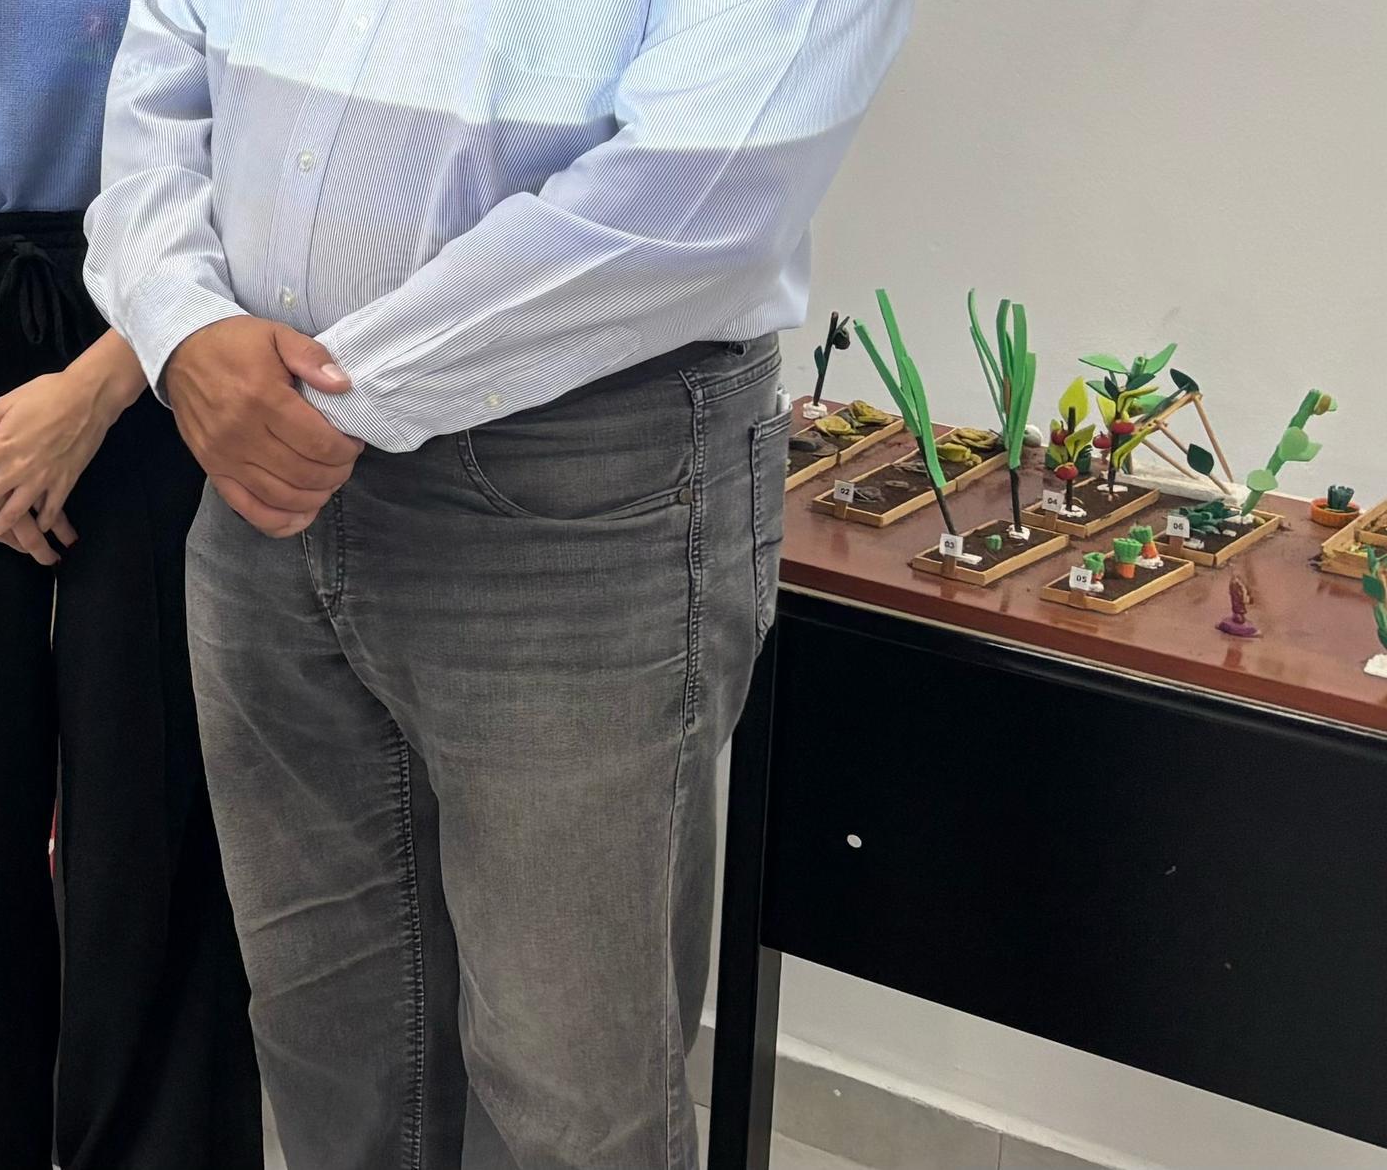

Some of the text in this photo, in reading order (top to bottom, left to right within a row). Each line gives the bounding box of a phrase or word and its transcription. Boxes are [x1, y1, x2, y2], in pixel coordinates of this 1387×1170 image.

[840, 487, 850, 496] 02
[1047, 497, 1058, 505] 04
[944, 540, 955, 549] 03
[1076, 575, 1087, 583] 05
